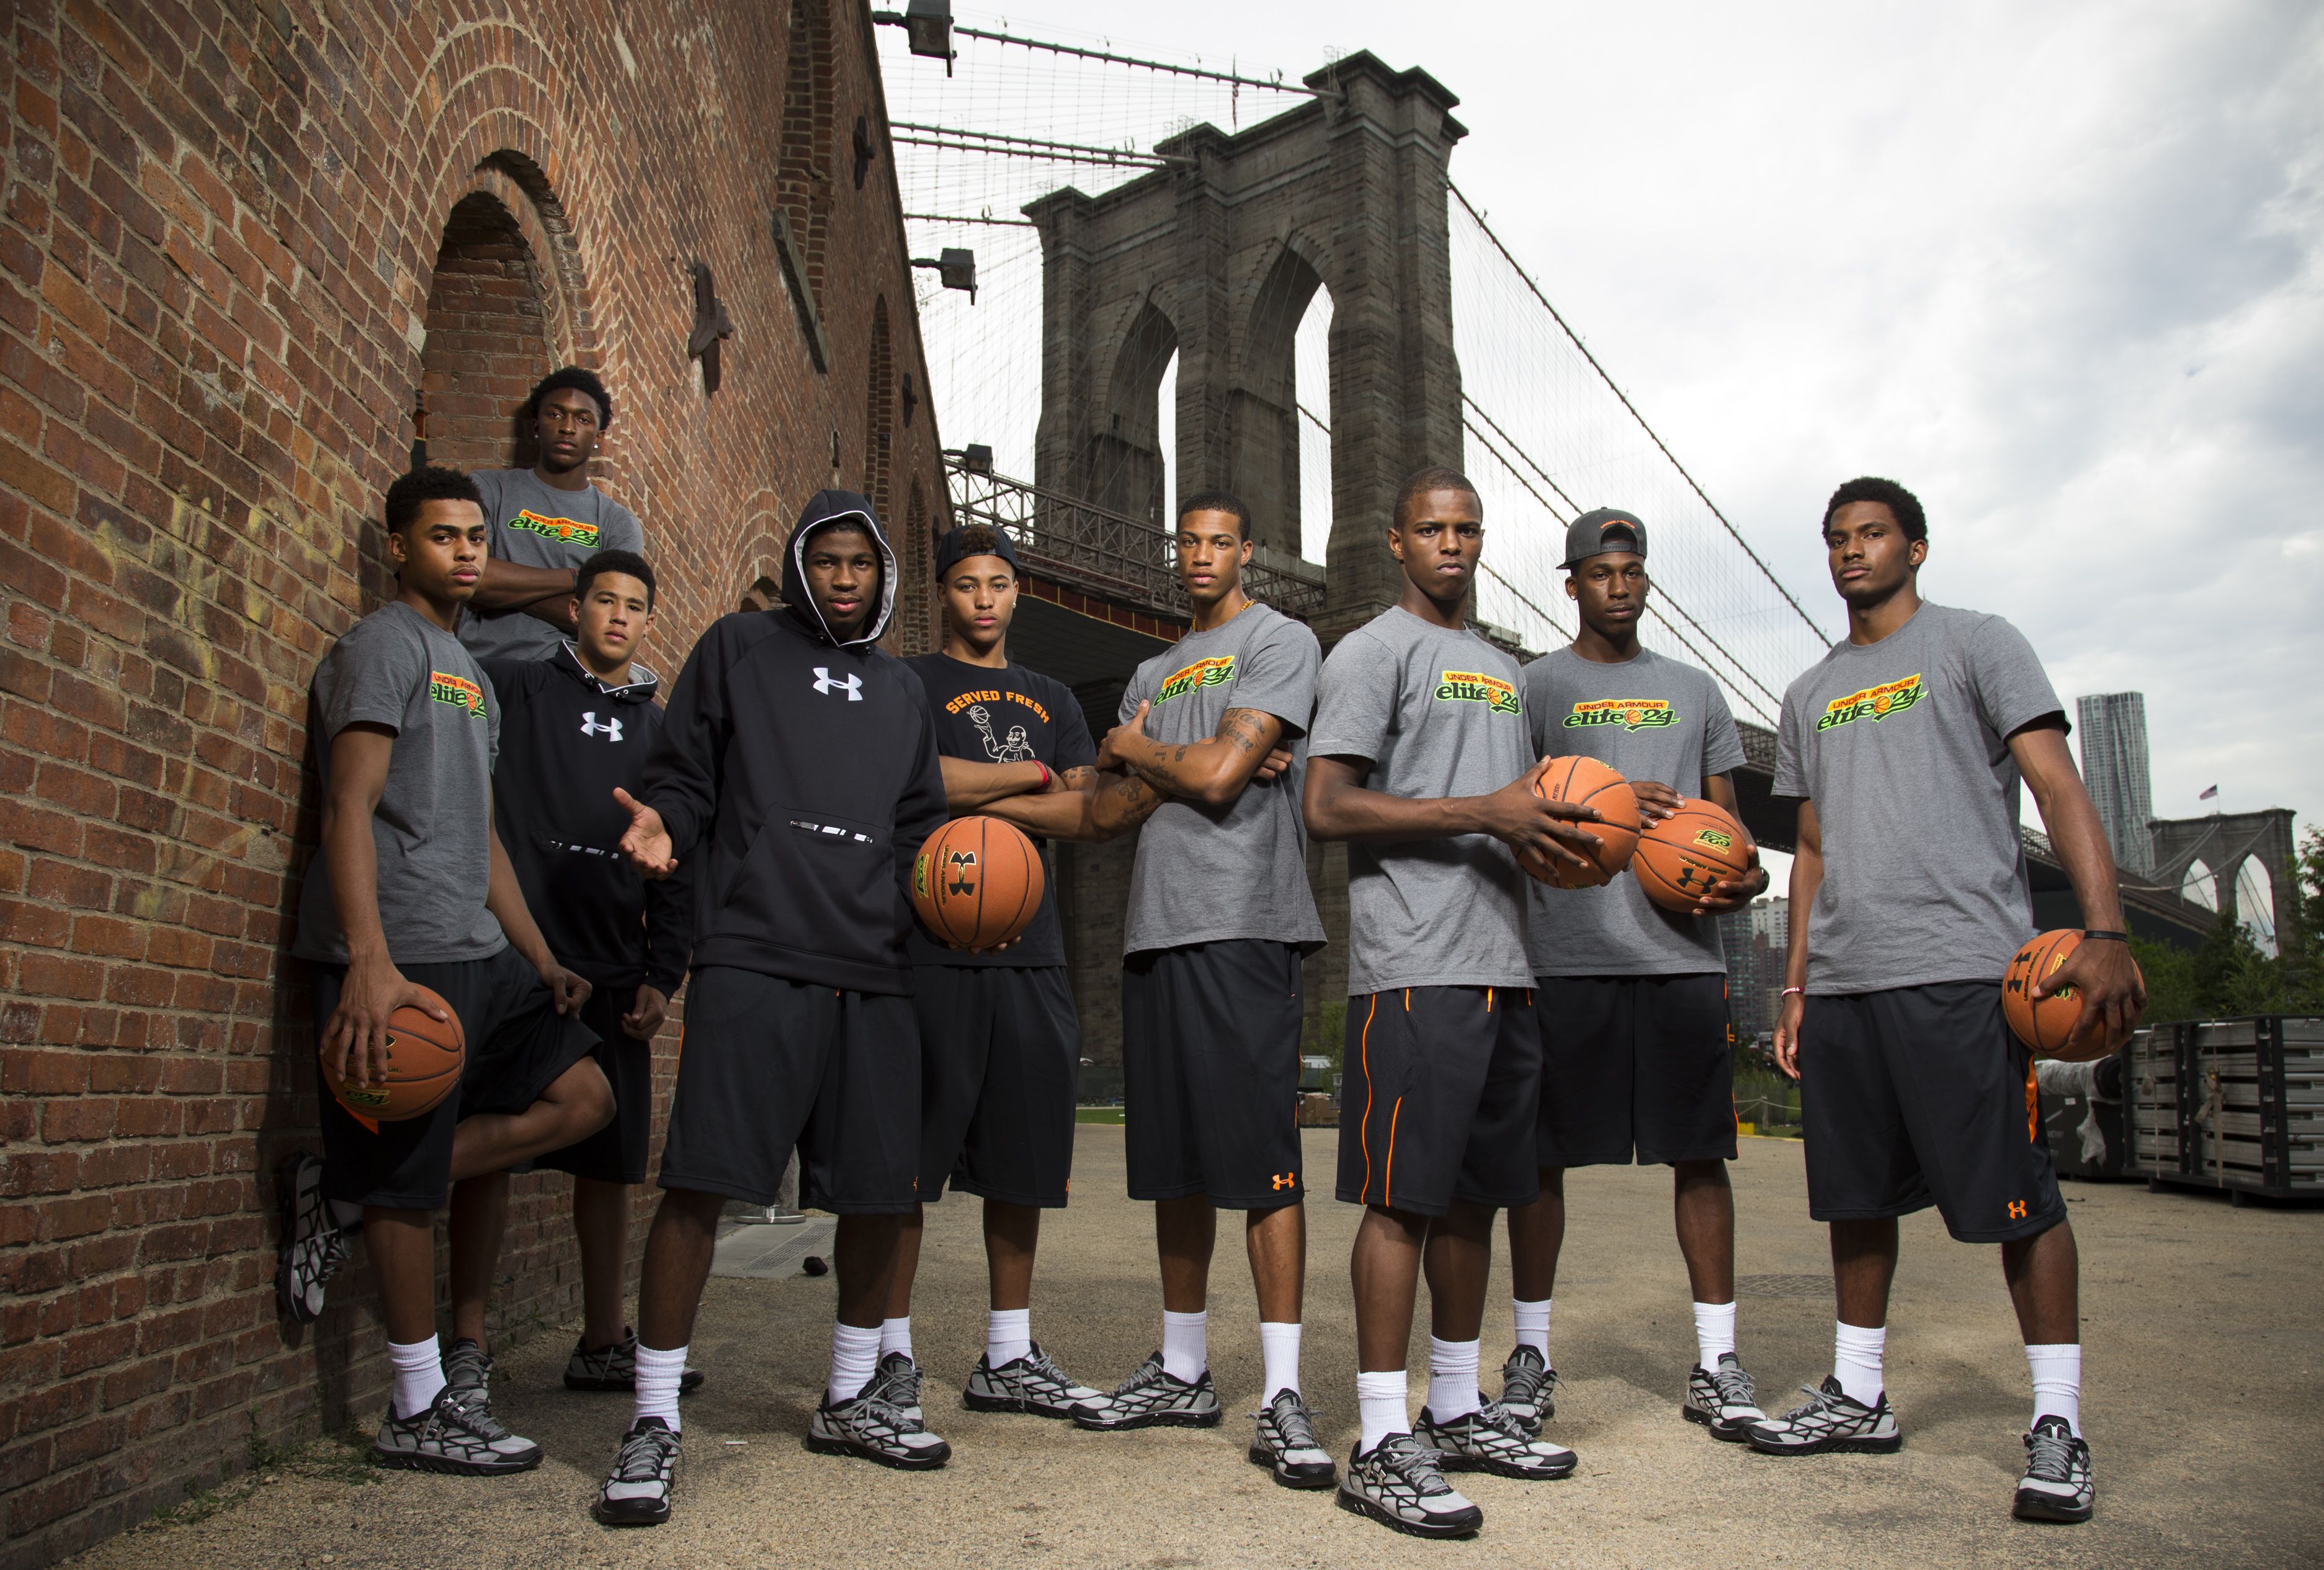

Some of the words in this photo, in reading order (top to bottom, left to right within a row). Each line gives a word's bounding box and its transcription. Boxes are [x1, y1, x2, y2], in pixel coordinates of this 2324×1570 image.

[508, 518, 559, 537] elite
[524, 511, 553, 524] UNDER
[555, 520, 594, 532] ARMOUR
[434, 674, 457, 687] UNDER
[1166, 669, 1190, 686] UNDER
[1192, 659, 1227, 673] ARMOUR
[1446, 673, 1478, 683] UNDER
[1482, 675, 1512, 691] ARMOUR
[1436, 683, 1488, 701] elite
[1490, 691, 1519, 715] 24
[1833, 693, 1867, 709] UNDER
[1870, 678, 1916, 698] ARMOUR
[470, 696, 487, 719] 2
[945, 690, 1001, 714] SERVED
[1006, 691, 1050, 724] FRESH
[1578, 701, 1614, 711] UNDER
[1817, 702, 1874, 732] elite
[1873, 682, 1928, 722] 24
[1563, 709, 1624, 728] elite
[1626, 709, 1679, 732] 24
[1697, 829, 1732, 848] e24
[1679, 855, 1707, 870] ARMOUR
[1708, 866, 1728, 876] UNDER
